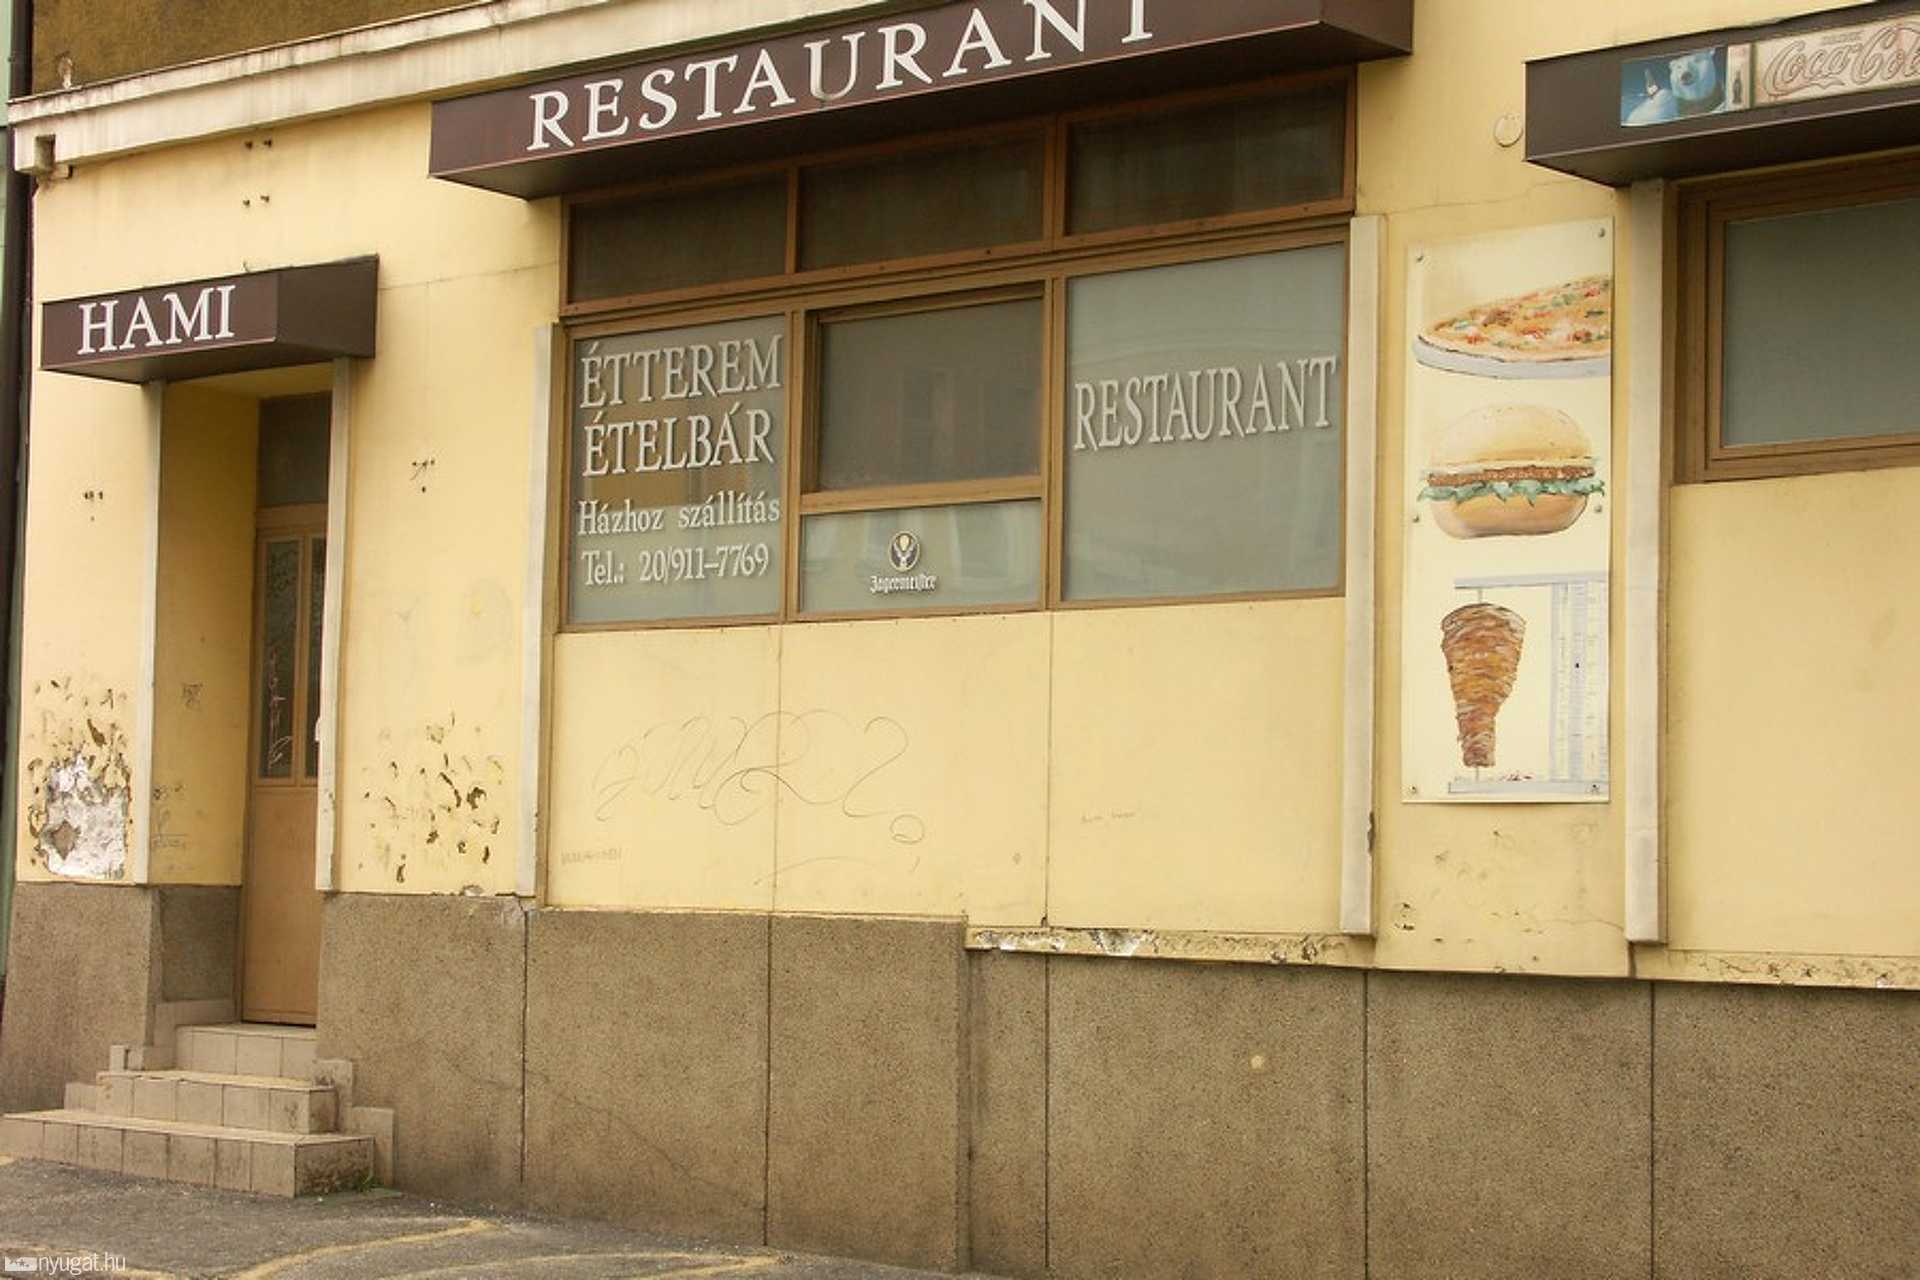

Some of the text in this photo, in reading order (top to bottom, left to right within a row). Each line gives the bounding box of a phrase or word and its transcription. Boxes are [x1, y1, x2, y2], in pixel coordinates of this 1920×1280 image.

[526, 0, 1153, 152] RESTAURANT
[77, 284, 236, 356] HAMI
[579, 334, 783, 409] ÉTTEREM
[1073, 355, 1337, 451] RESTAURANT
[582, 402, 775, 478] ÉTELBÁR
[576, 490, 781, 536] Házhoz szállítás
[580, 549, 625, 586] Tel.:
